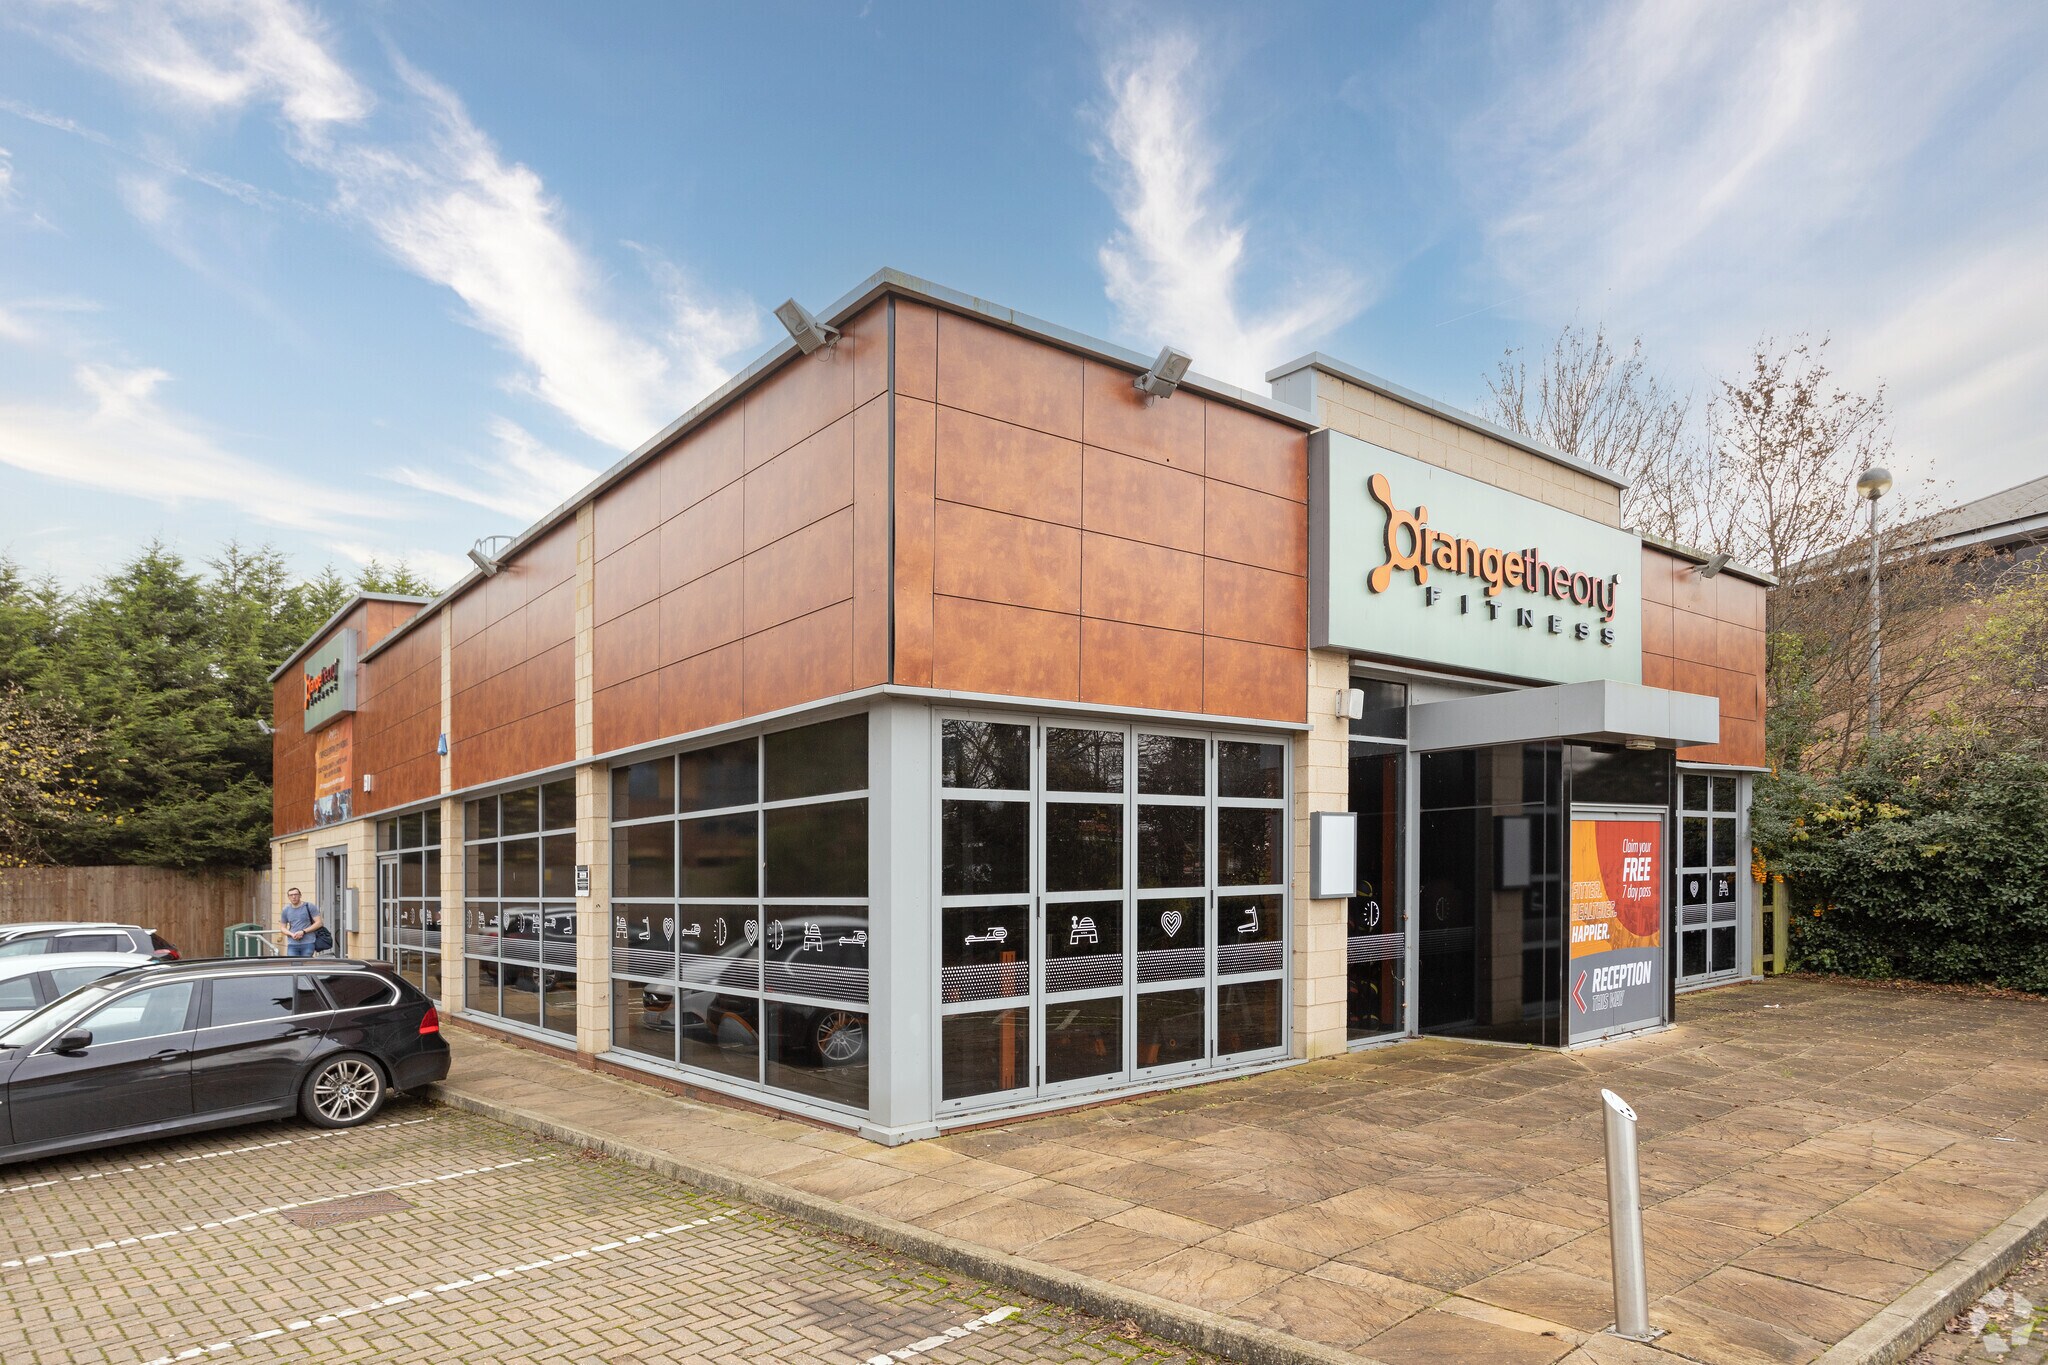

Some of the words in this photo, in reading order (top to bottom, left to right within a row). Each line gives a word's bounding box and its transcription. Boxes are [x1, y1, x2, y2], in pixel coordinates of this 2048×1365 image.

[1425, 586, 1616, 646] FITNESS
[1622, 838, 1638, 853] Claim
[1638, 842, 1651, 856] your
[1623, 857, 1651, 882] FREE
[1622, 884, 1627, 899] 7
[1627, 884, 1638, 901] day
[1638, 886, 1651, 901] pass
[1571, 923, 1610, 943] HAPPIER.
[1592, 960, 1652, 993] RECEPTION
[1592, 992, 1609, 1012] THIS
[1609, 989, 1625, 1009] WAY
